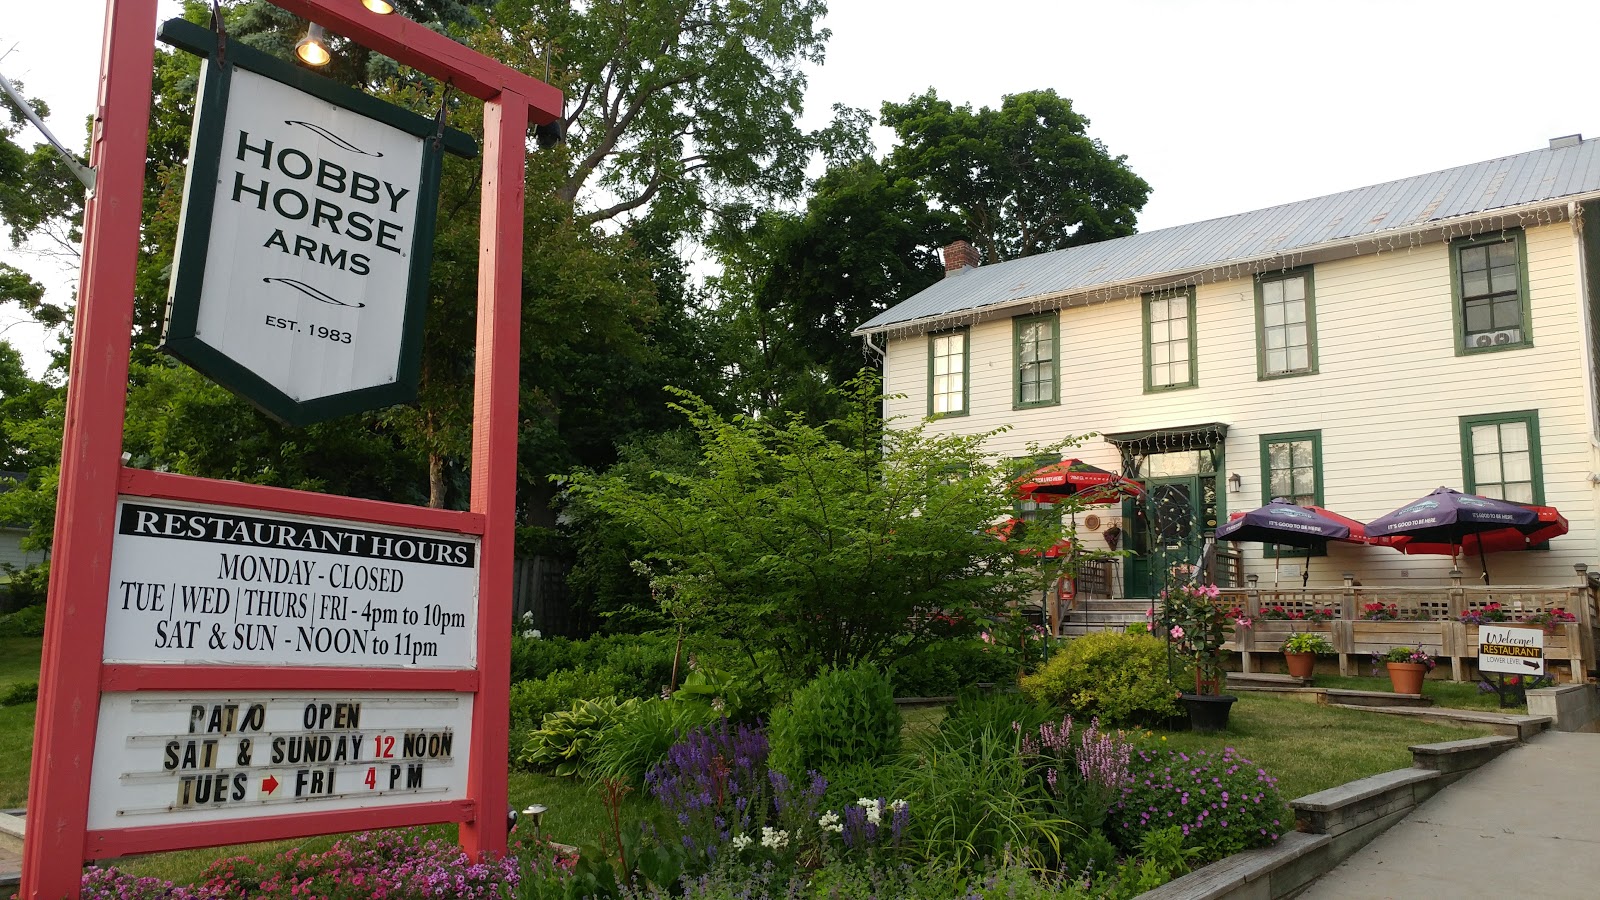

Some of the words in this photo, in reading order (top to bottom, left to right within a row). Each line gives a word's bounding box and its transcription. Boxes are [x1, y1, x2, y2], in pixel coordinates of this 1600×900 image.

[236, 130, 410, 213] HOBBY
[231, 171, 404, 255] HORSE
[263, 228, 371, 276] ARMS
[265, 315, 301, 333] EST.
[309, 324, 352, 344] 1983
[134, 511, 365, 553] RESTAURANT
[370, 536, 467, 564] HOURS
[217, 553, 316, 585] MONDAY
[329, 563, 404, 593] CLOSED
[120, 580, 165, 611] TUE
[181, 585, 230, 614] WED
[244, 589, 307, 618] THURS
[319, 594, 348, 621] FRI
[361, 600, 398, 631] 4pm
[403, 606, 419, 625] to
[423, 604, 465, 635] 10pm
[154, 620, 201, 649] SAT
[208, 623, 229, 650] &
[233, 623, 277, 651] SUN
[295, 626, 368, 654] NOON
[372, 635, 389, 655] to
[394, 633, 438, 664] 11pm
[1484, 645, 1539, 657] RESTAURANT
[1486, 630, 1534, 647] Welcome!
[303, 703, 360, 729] OPEN
[164, 739, 218, 770] SAT
[237, 738, 251, 766] &
[271, 735, 363, 764] SUNDAY
[374, 735, 395, 758] 12
[402, 732, 453, 758] NOON
[180, 772, 247, 804] TUES
[295, 767, 335, 797] FRI
[364, 767, 376, 789] 4
